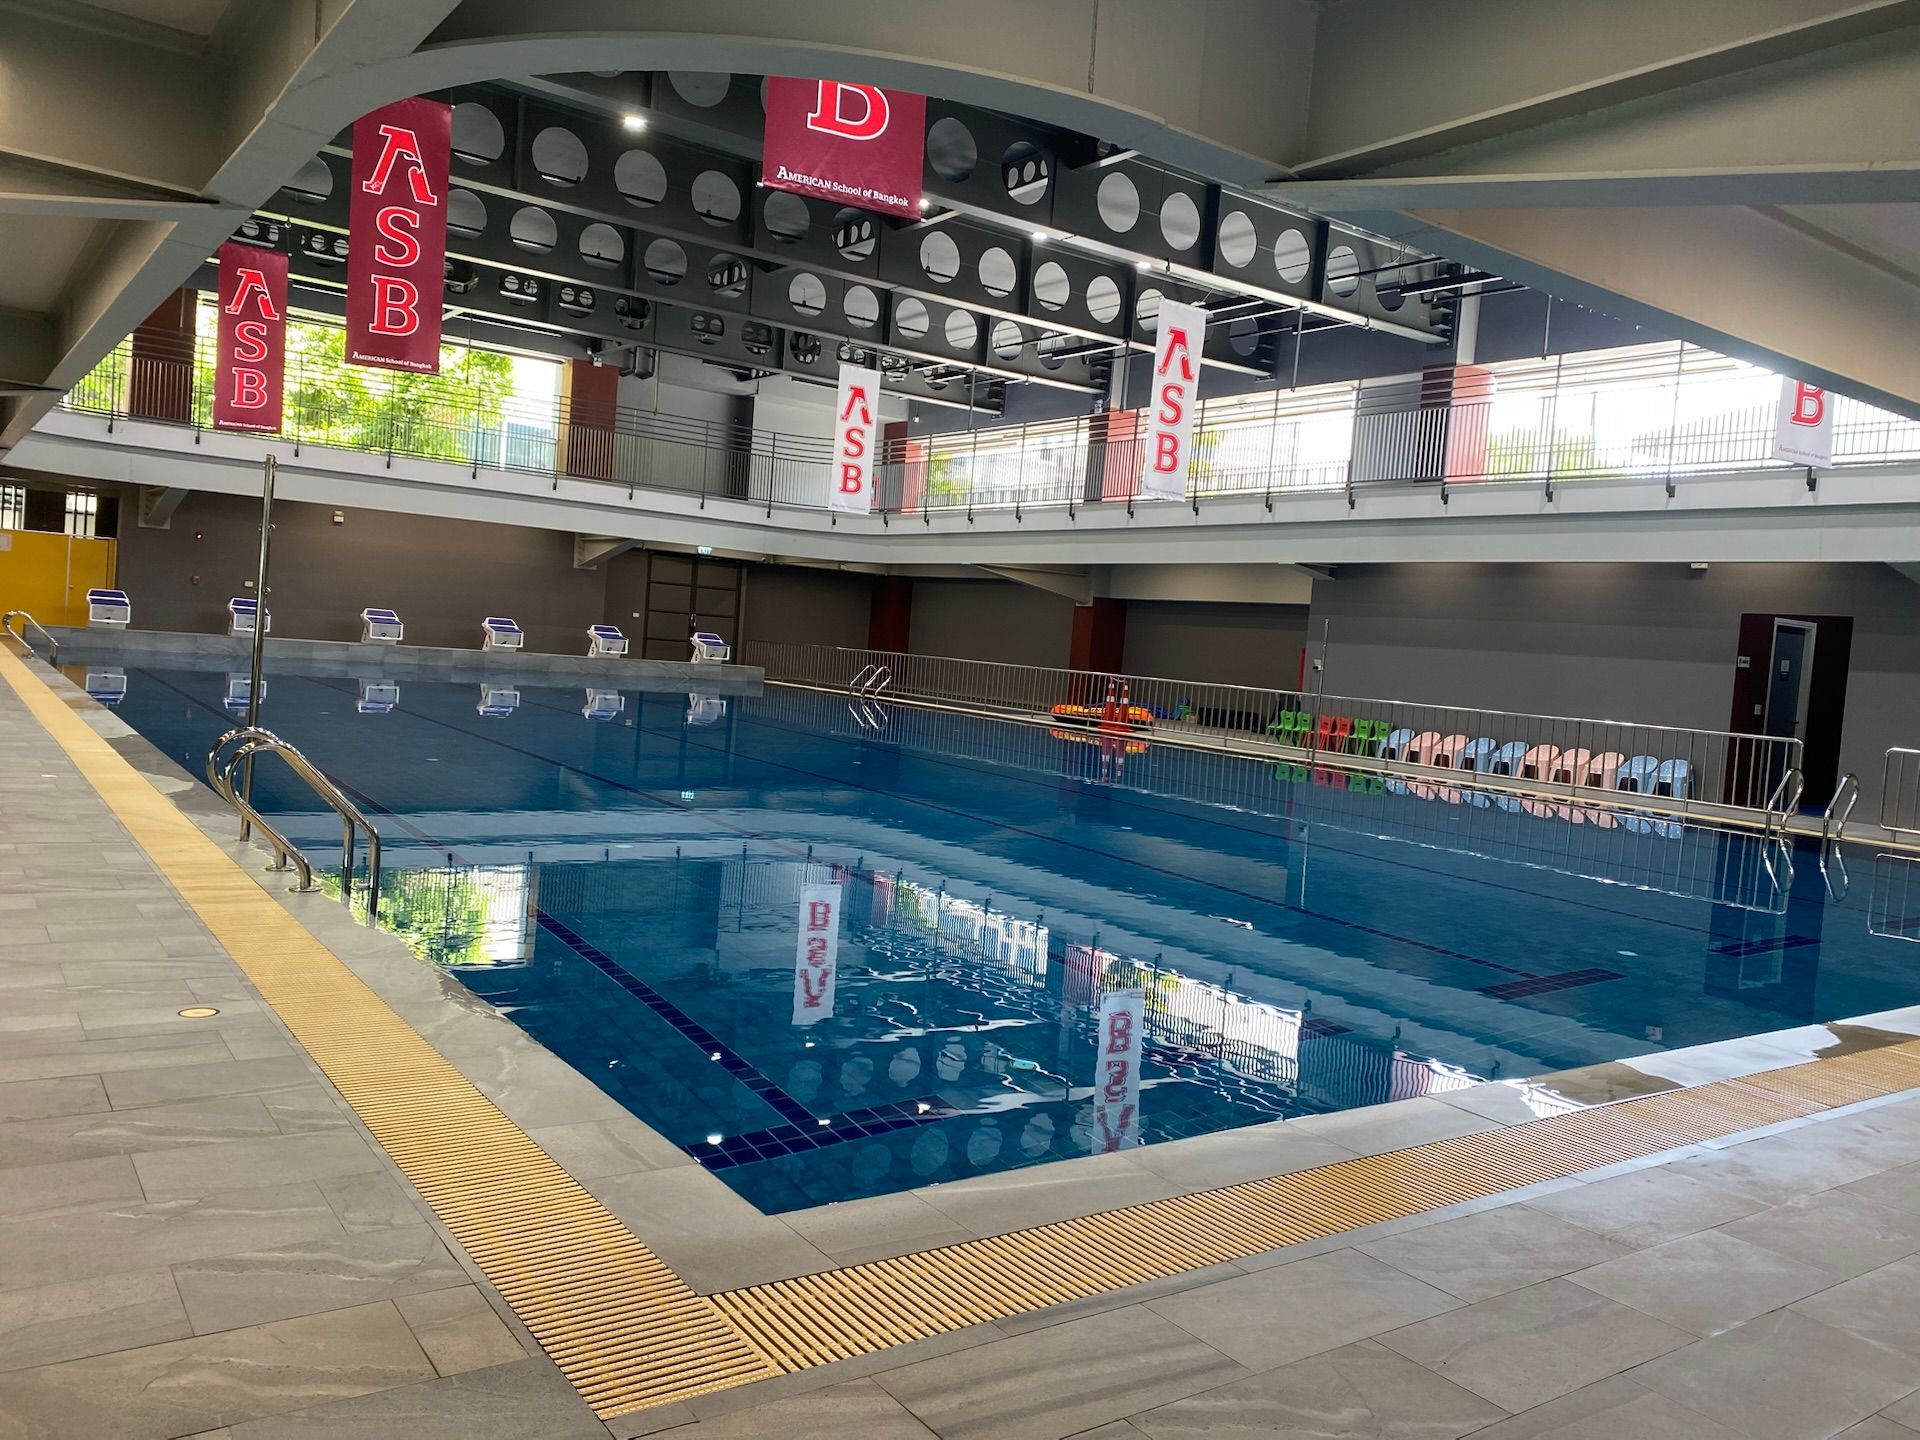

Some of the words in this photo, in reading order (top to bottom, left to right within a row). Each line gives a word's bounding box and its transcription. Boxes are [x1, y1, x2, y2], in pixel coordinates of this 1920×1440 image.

[362, 124, 438, 337] ASB
[776, 165, 832, 190] AMERICAN
[832, 182, 861, 197] School
[862, 188, 873, 198] of
[873, 190, 909, 207] Bangkok
[225, 267, 280, 410] ASB
[1152, 325, 1195, 475] ASB
[839, 383, 873, 495] ASB
